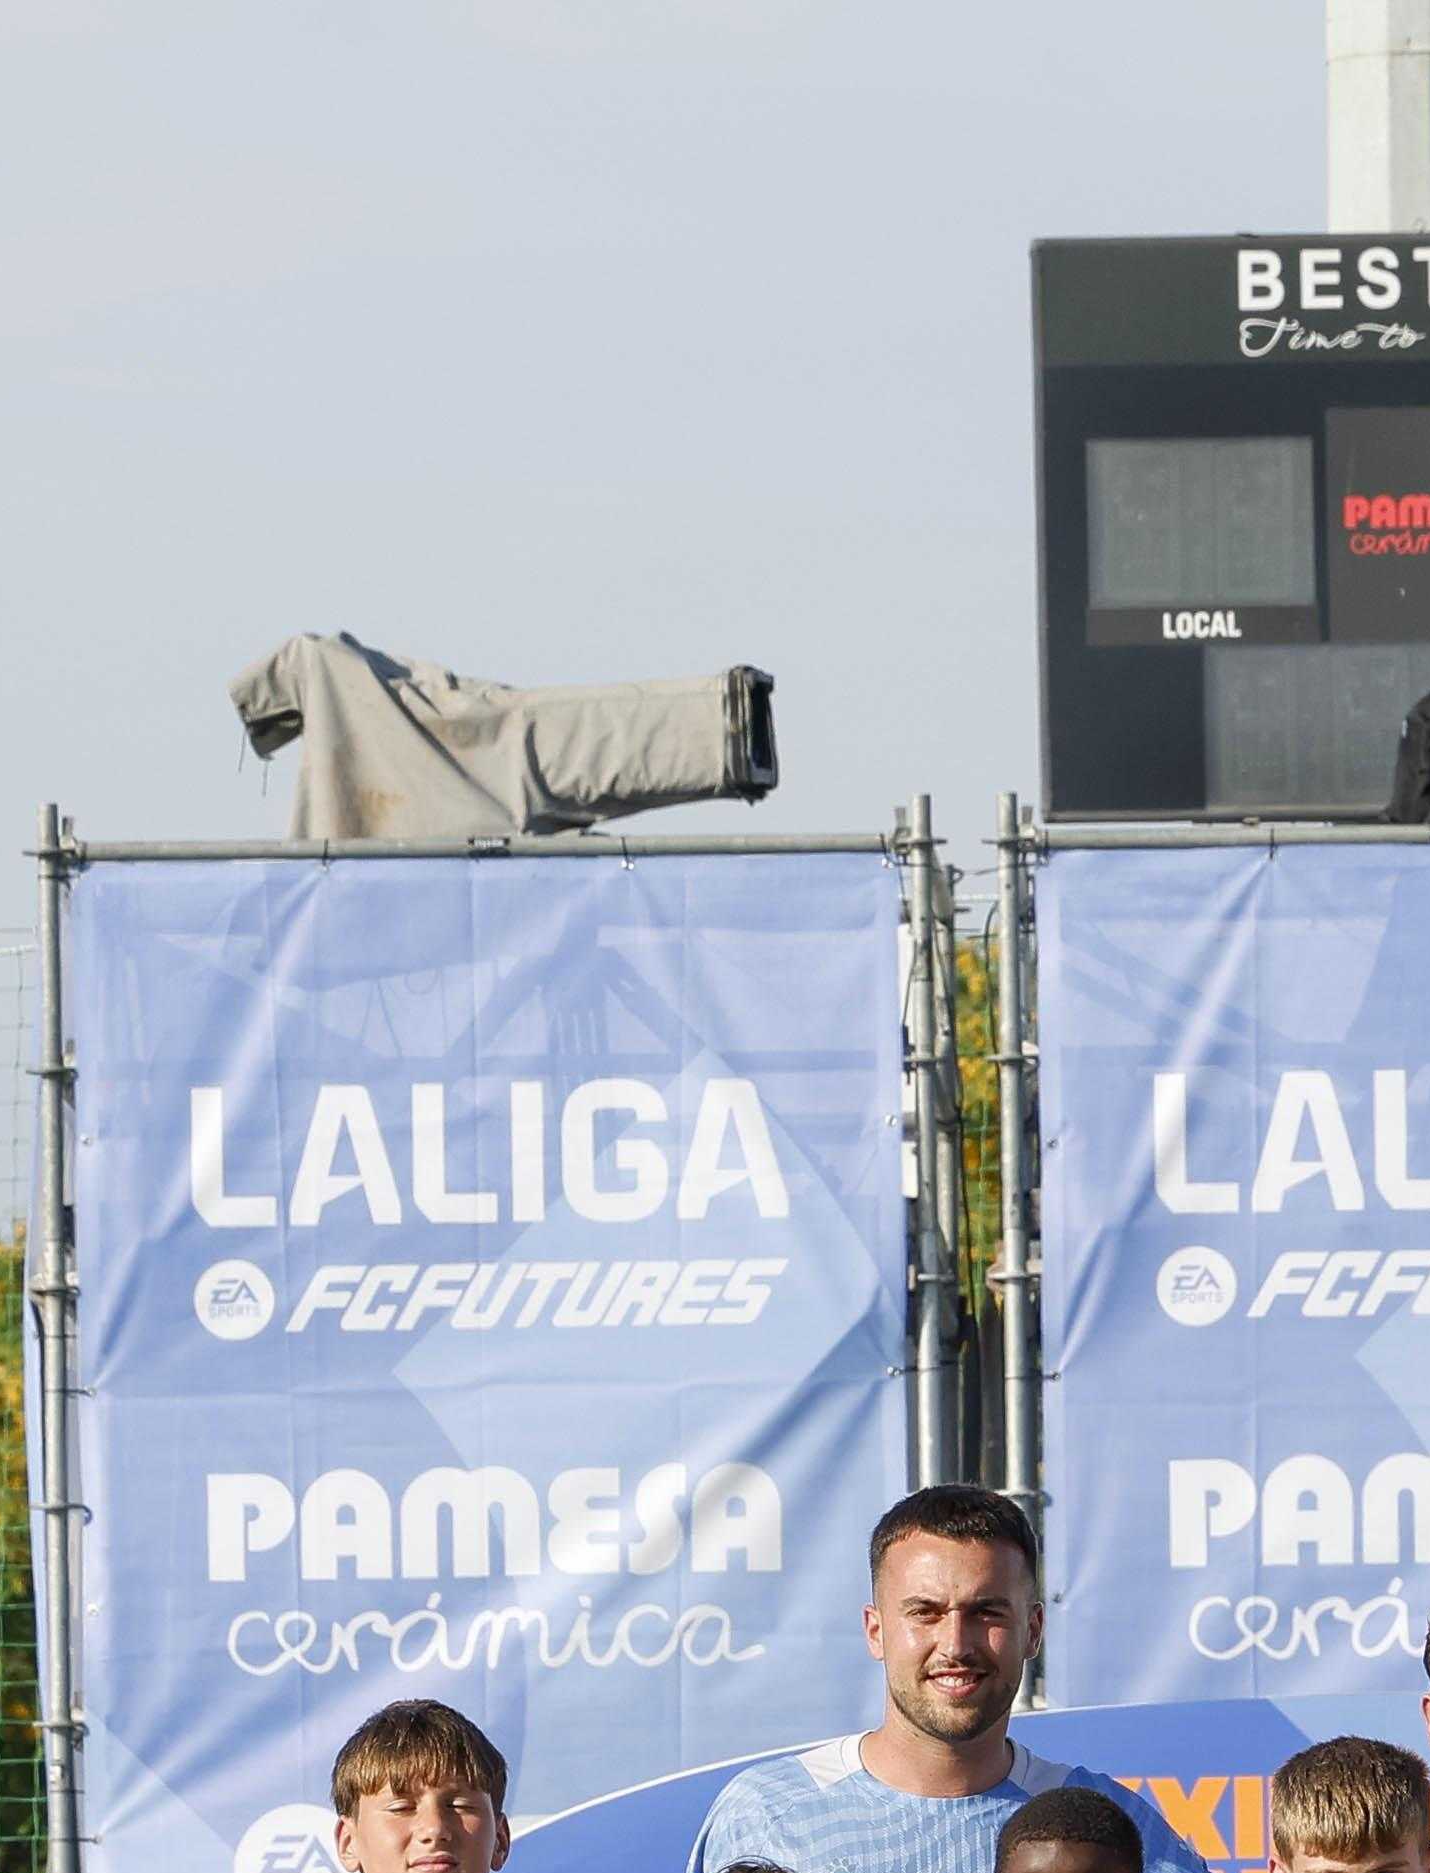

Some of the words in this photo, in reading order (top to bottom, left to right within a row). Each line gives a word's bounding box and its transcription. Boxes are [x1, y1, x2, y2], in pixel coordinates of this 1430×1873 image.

[1239, 317, 1363, 357] Time
[1358, 323, 1426, 349] to
[1162, 610, 1242, 639] LOCAL
[190, 1078, 790, 1228] LALIGA
[206, 1462, 783, 1582] PAMESA
[228, 1592, 766, 1676] cerámica
